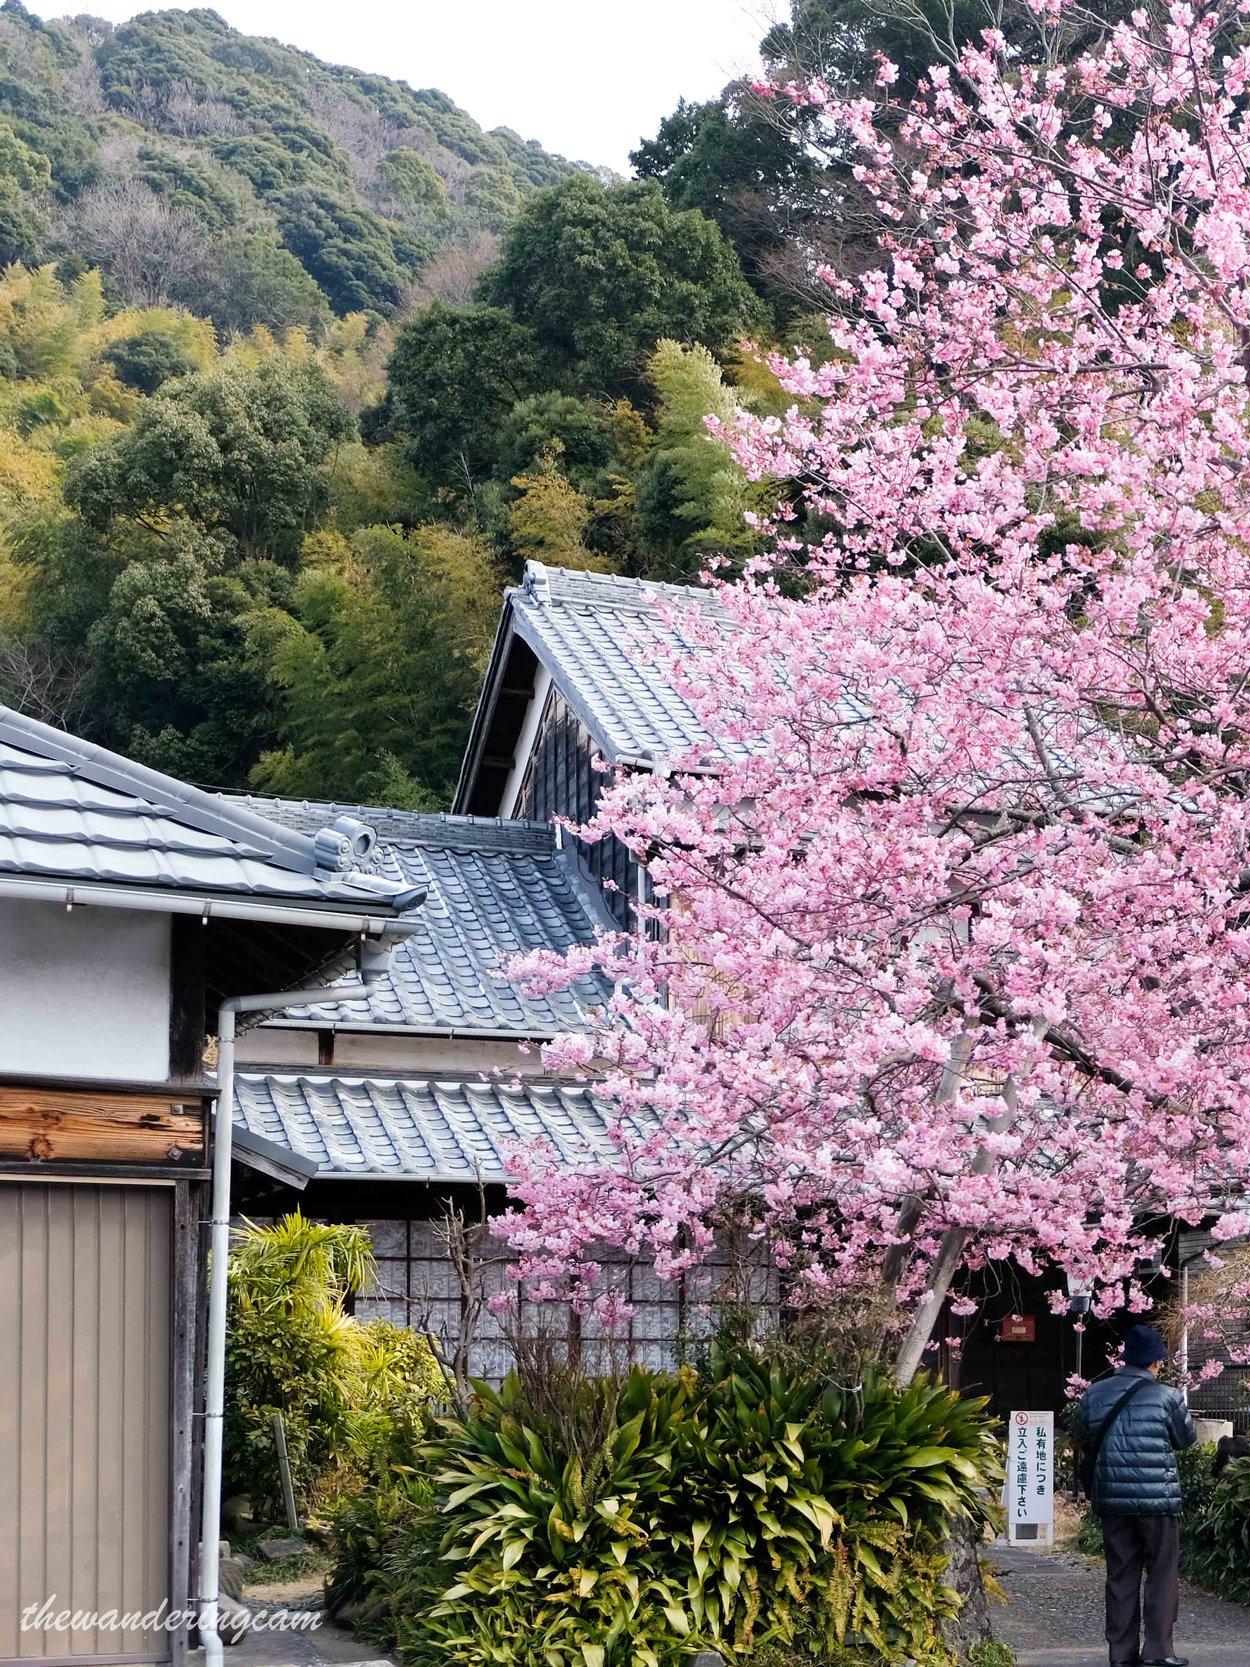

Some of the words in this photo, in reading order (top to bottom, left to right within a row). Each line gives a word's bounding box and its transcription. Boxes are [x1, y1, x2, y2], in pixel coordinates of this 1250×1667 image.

[1017, 1427, 1028, 1517] 立入ご遠慮下さい
[1036, 1427, 1046, 1495] 私有地につき
